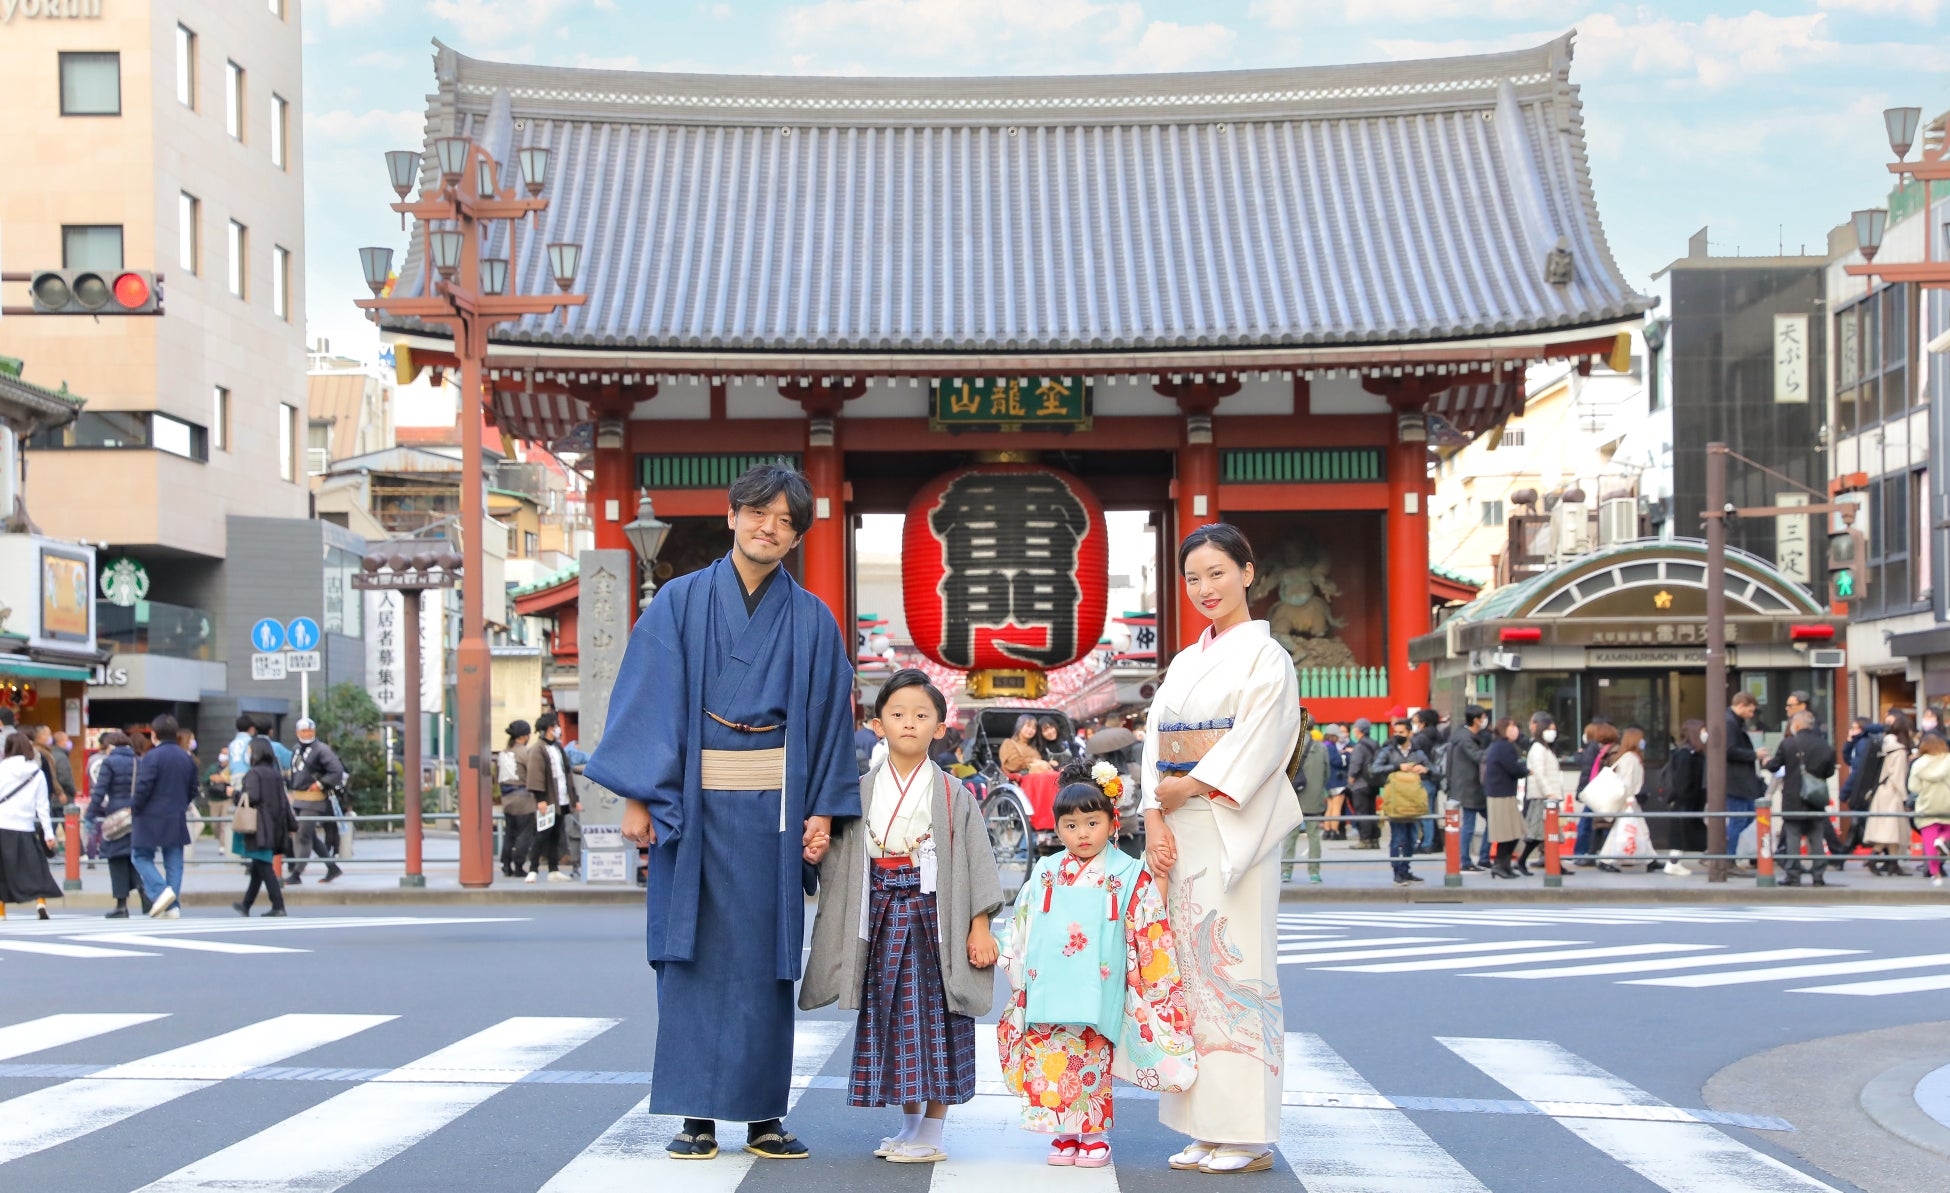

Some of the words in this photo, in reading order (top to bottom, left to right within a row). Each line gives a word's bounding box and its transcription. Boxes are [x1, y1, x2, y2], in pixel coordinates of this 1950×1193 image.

[377, 590, 395, 705] 入居者募集中
[1596, 652, 1678, 662] KAMINARIMON
